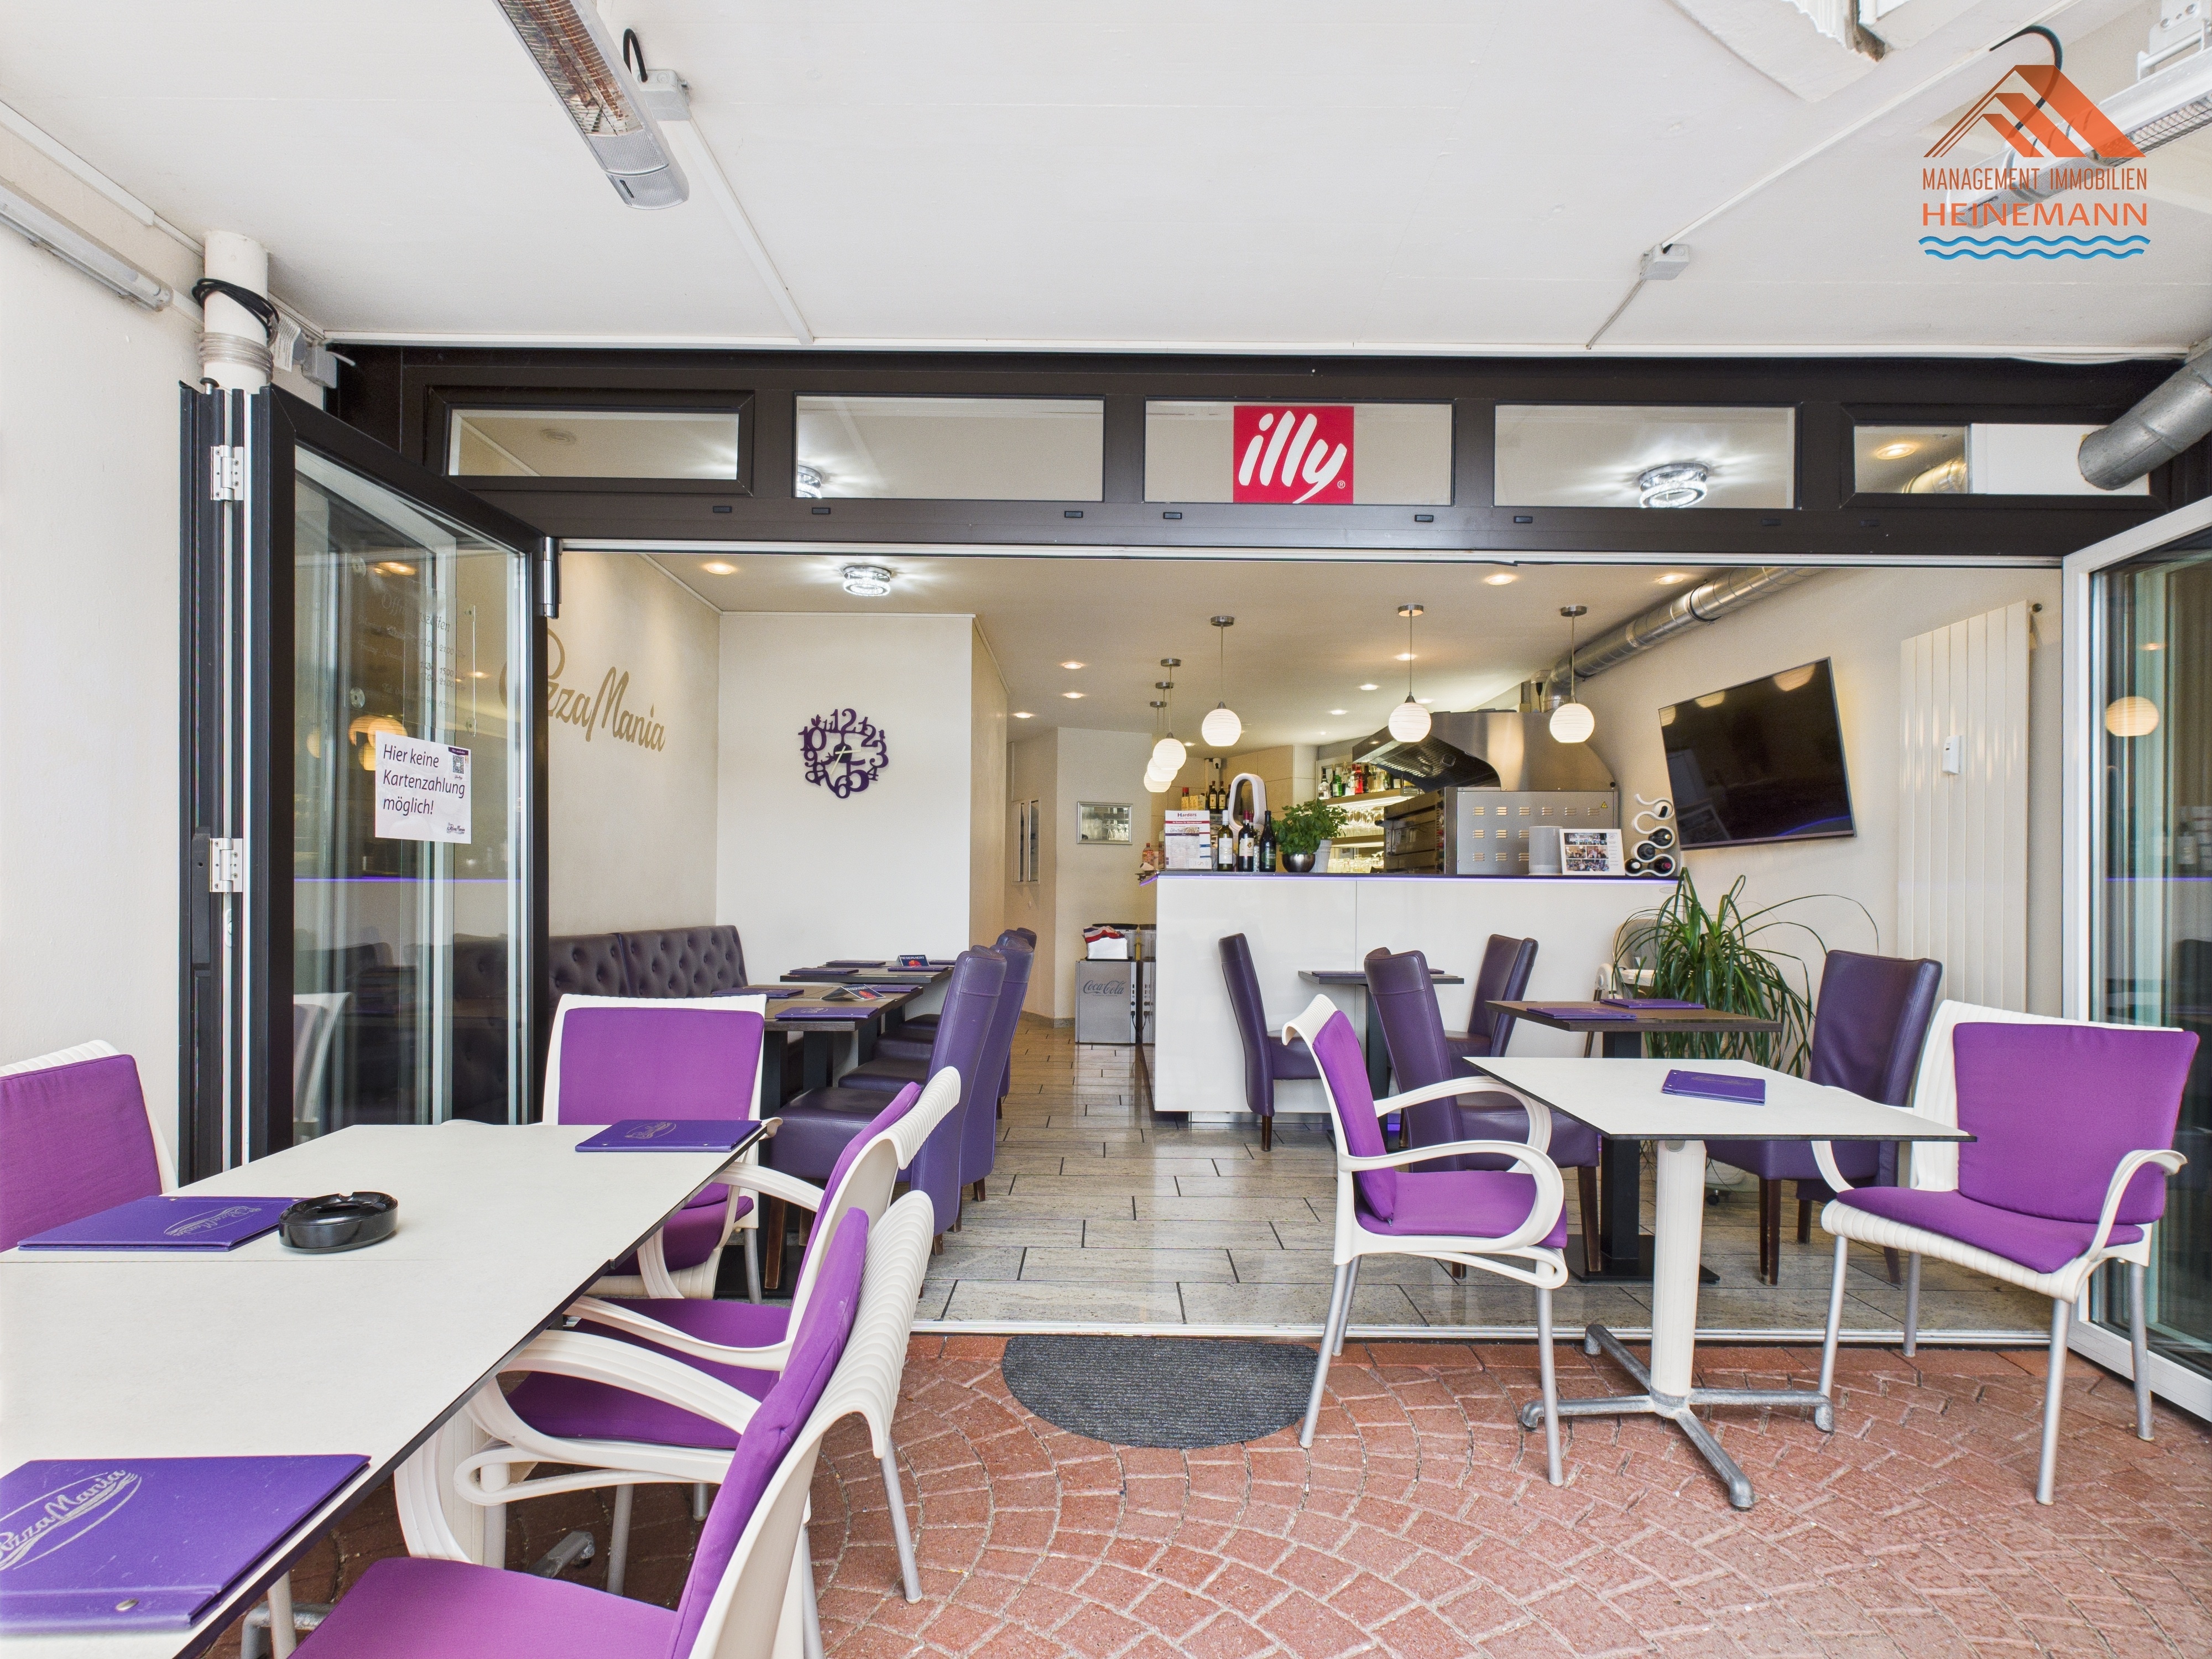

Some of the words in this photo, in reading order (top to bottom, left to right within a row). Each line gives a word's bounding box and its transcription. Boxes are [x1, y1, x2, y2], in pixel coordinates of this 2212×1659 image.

[1238, 410, 1348, 504] illy
[830, 708, 857, 733] 12
[798, 726, 827, 751] 10
[861, 724, 877, 747] 2
[383, 744, 408, 763] Hier
[410, 748, 439, 768] keine
[869, 740, 889, 768] 3
[383, 769, 465, 799] Kartenzahlung
[834, 775, 851, 799] 6
[383, 796, 434, 816] möglich!
[1083, 980, 1126, 994] Coca-Cola
